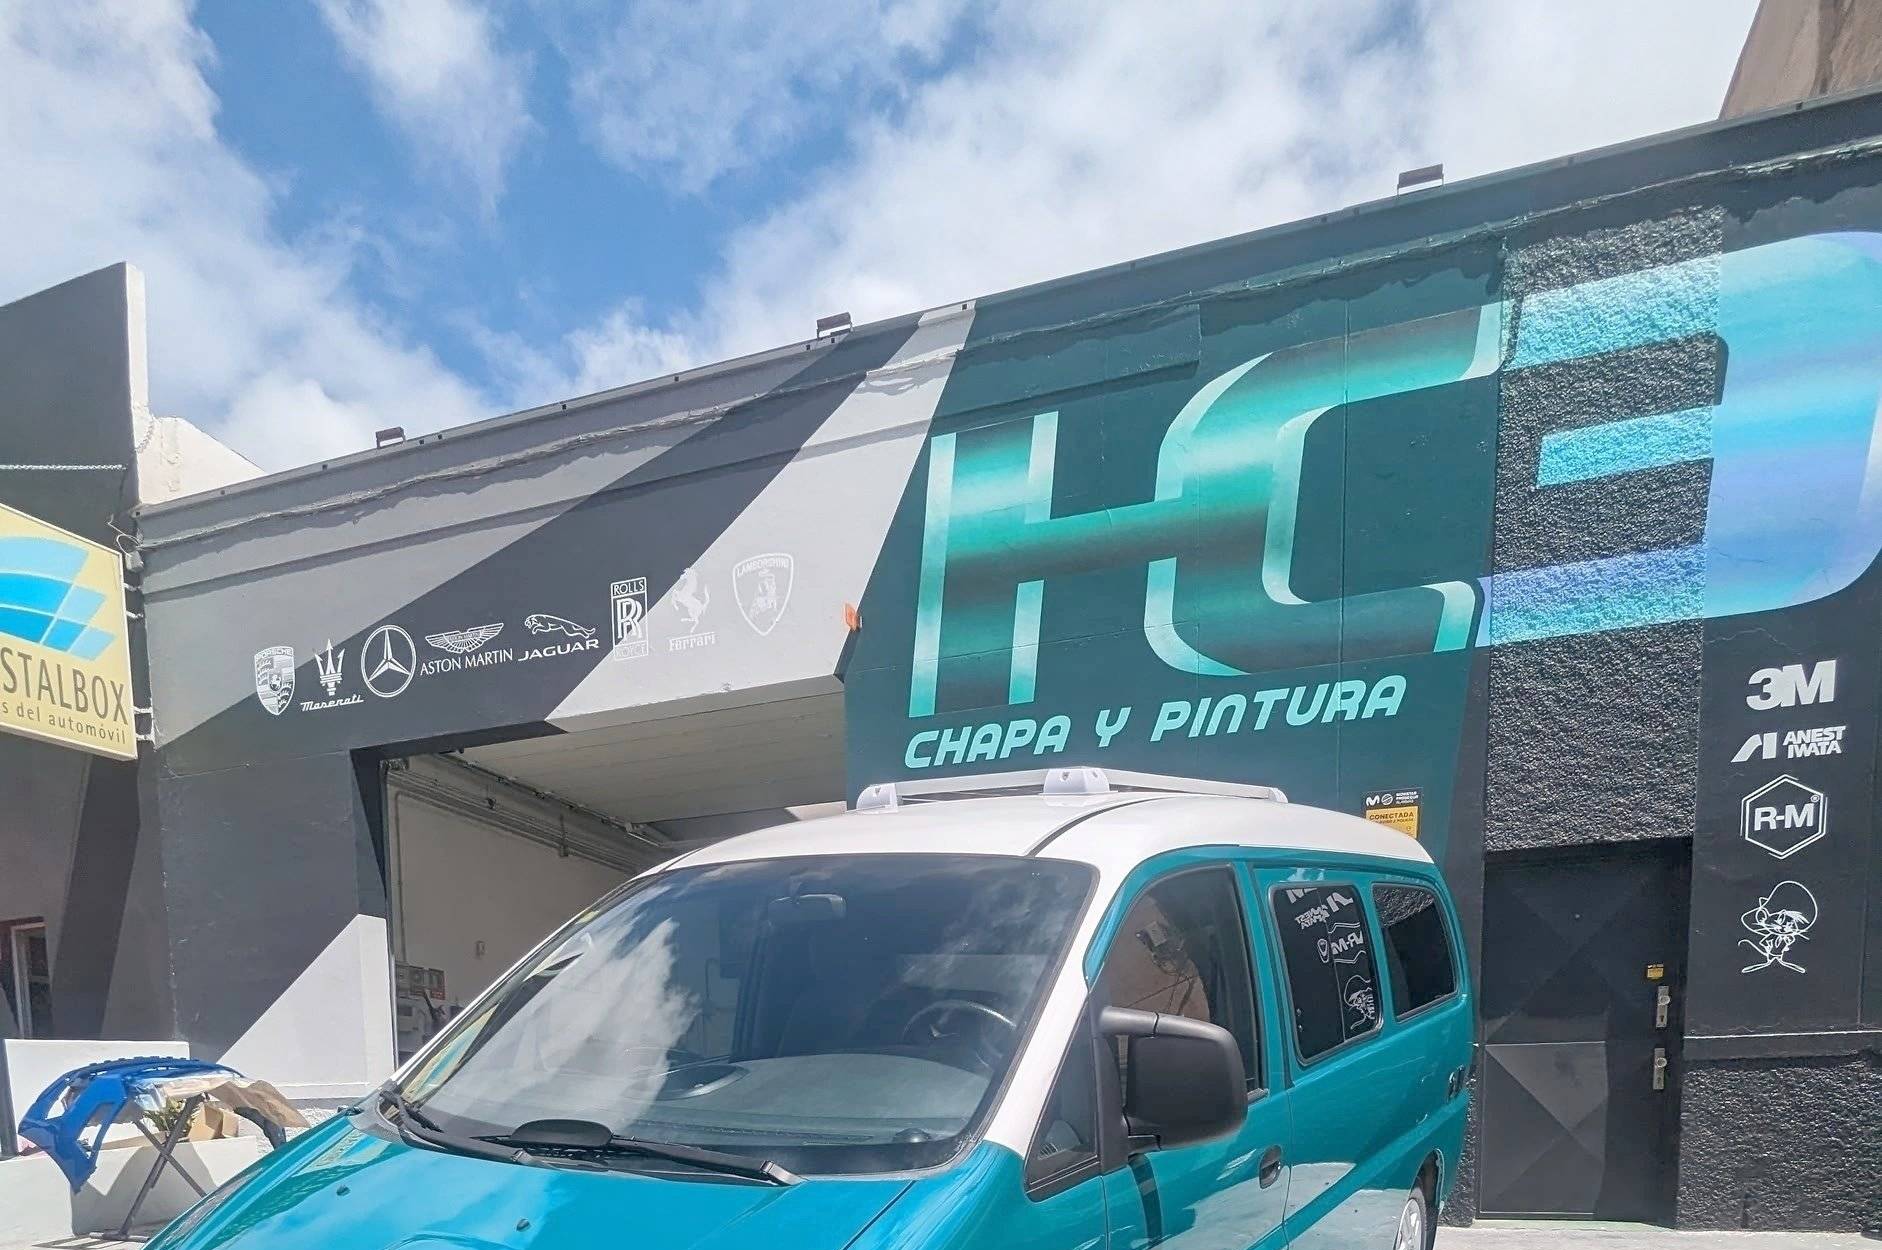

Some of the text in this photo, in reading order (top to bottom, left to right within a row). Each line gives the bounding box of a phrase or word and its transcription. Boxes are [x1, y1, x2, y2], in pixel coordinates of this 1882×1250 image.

[613, 580, 644, 596] ROLLS
[518, 638, 600, 662] JAGUAR
[668, 632, 716, 652] Ferrari
[420, 648, 513, 676] ASTON MARTIN
[0, 647, 128, 725] STALBOX
[1746, 660, 1836, 711] 3M
[301, 694, 364, 712] Maserati
[16, 702, 40, 722] del
[48, 714, 126, 745] automóvil
[904, 675, 1407, 769] CHAPA Y PINTURA
[1782, 726, 1847, 746] ANEST
[1787, 740, 1842, 759] IWATA
